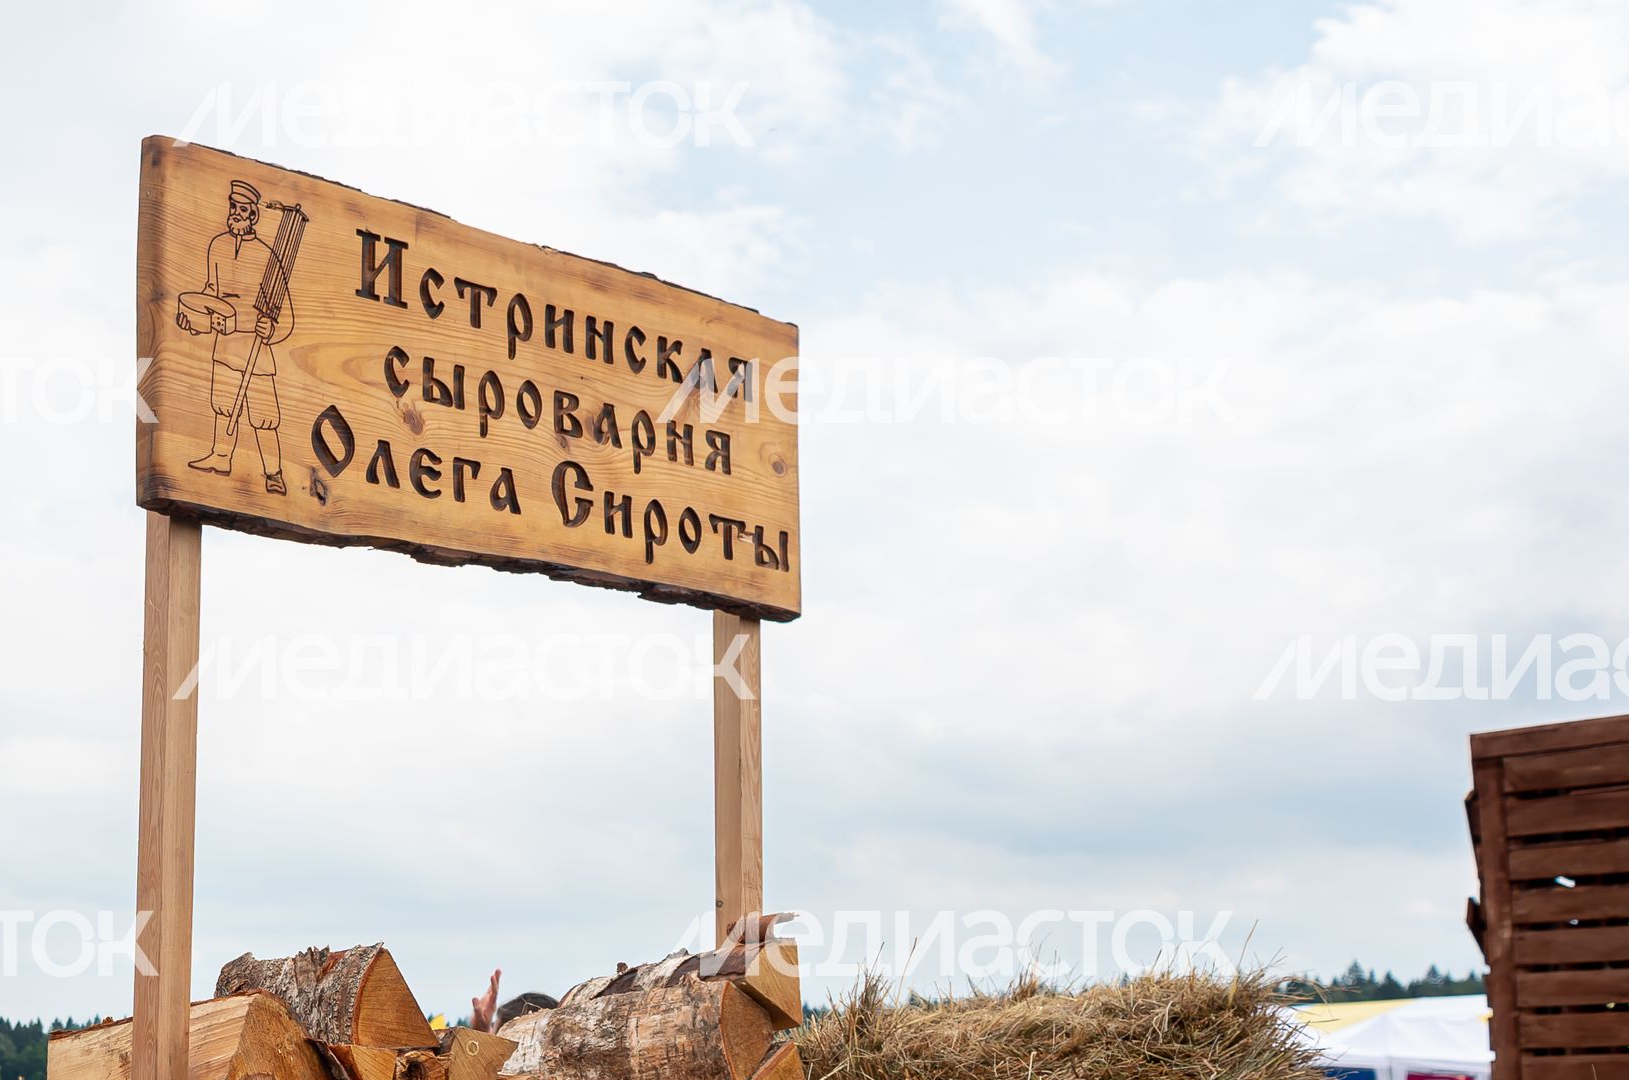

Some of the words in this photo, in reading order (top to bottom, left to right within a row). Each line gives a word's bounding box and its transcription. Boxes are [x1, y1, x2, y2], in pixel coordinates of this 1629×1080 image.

[354, 228, 754, 402] Истринская
[311, 403, 523, 515] Олега
[550, 459, 791, 573] Сироты
[383, 345, 733, 475] сыроварня
